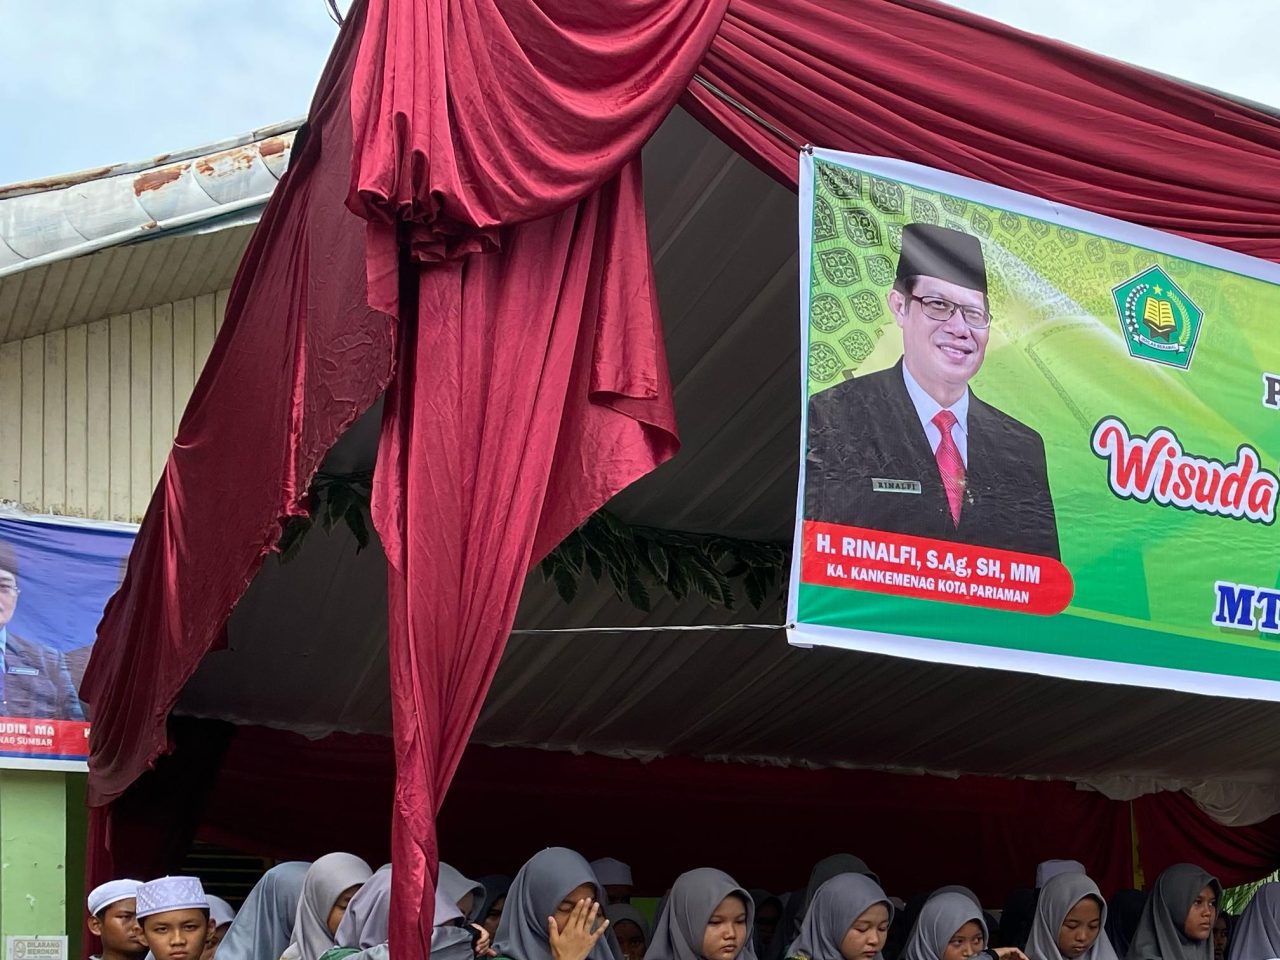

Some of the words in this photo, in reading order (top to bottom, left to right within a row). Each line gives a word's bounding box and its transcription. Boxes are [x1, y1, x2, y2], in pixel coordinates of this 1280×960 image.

[1096, 422, 1276, 520] Wisuda
[817, 532, 836, 555] H.
[842, 536, 922, 571] RINALFI,
[926, 549, 972, 578] S.Ag,
[976, 557, 1006, 581] SH,
[1010, 563, 1041, 584] MM
[827, 563, 848, 579] KA.
[851, 566, 935, 591] KANKEMENAG
[937, 578, 968, 596] KOTA
[970, 585, 1030, 604] PARIAMAN
[16, 737, 53, 747] SUMBAR
